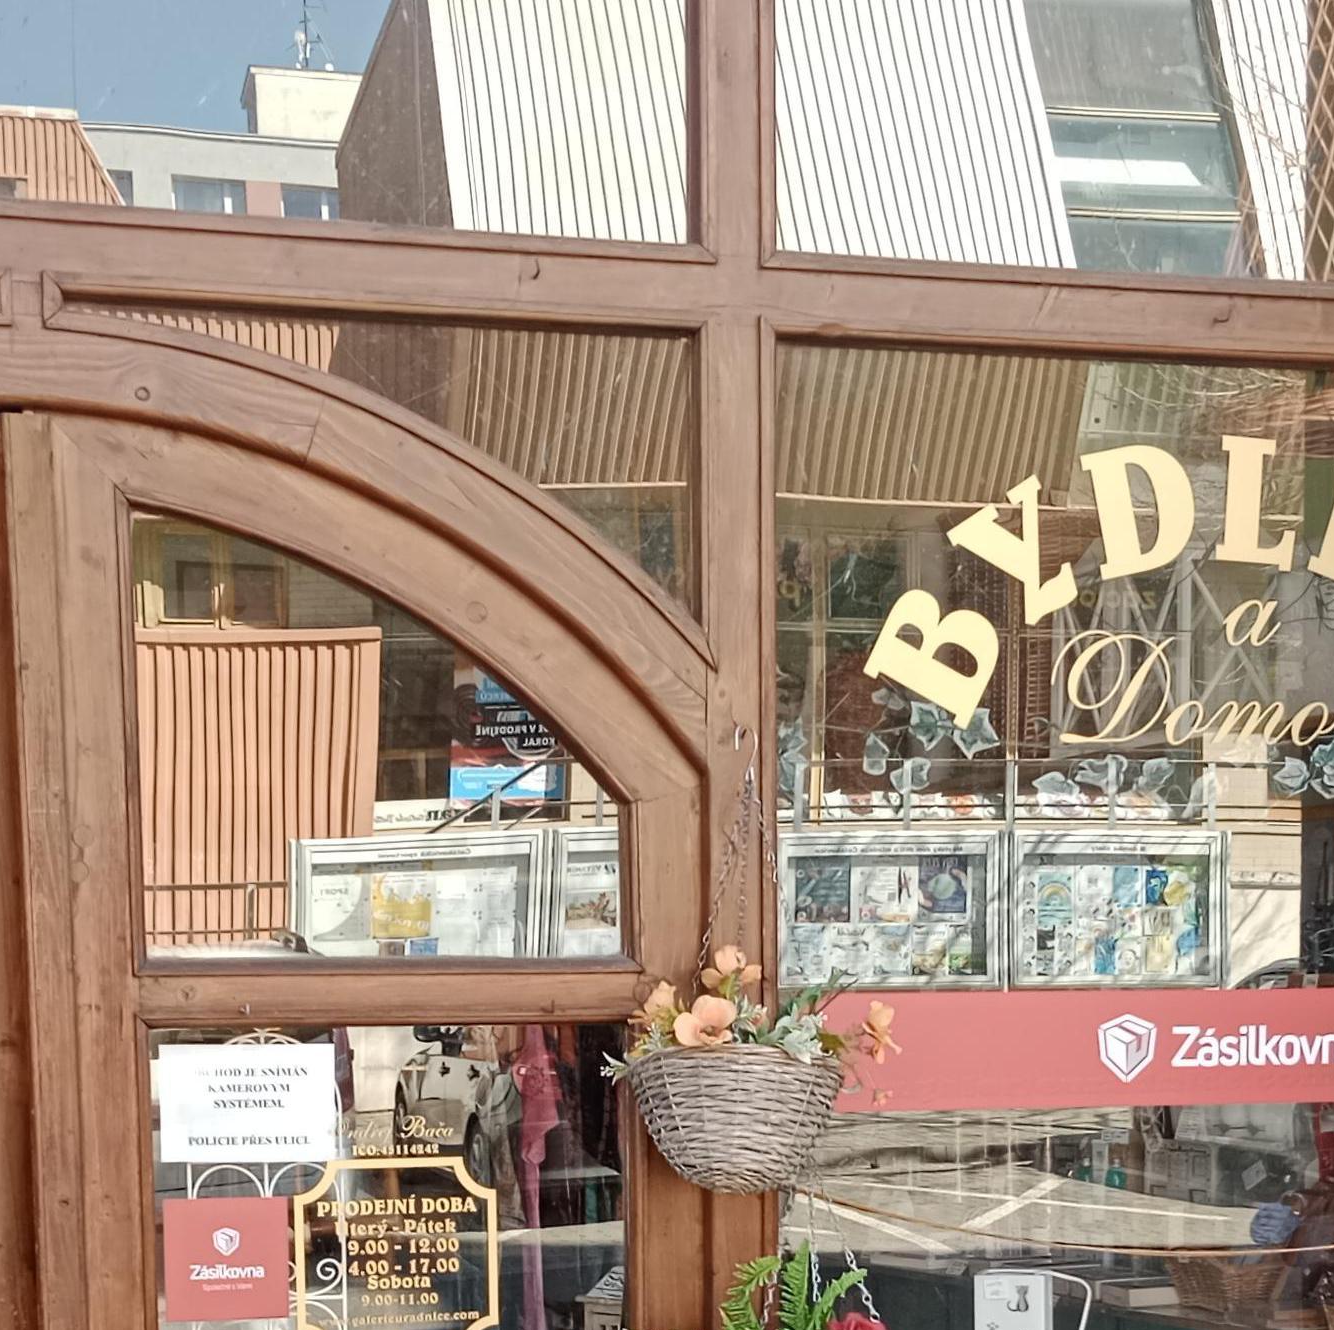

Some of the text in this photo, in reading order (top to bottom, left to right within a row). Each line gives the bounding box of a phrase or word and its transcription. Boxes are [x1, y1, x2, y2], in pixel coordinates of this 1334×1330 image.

[1220, 597, 1281, 648] a
[245, 1067, 258, 1078] JE
[260, 1064, 309, 1078] SNÍMÁN
[400, 1114, 455, 1139] Bača
[187, 1135, 239, 1147] POLICIE
[241, 1133, 273, 1146] PŘES
[421, 1196, 478, 1215] DOBA
[403, 1217, 457, 1235] Pátek
[347, 1239, 389, 1256] 9.00
[409, 1237, 460, 1254] 12.00
[188, 1263, 266, 1281] Zásilkovna
[341, 1260, 389, 1277] 4.00
[409, 1257, 460, 1275] 17.00
[366, 1274, 432, 1290] Sobota
